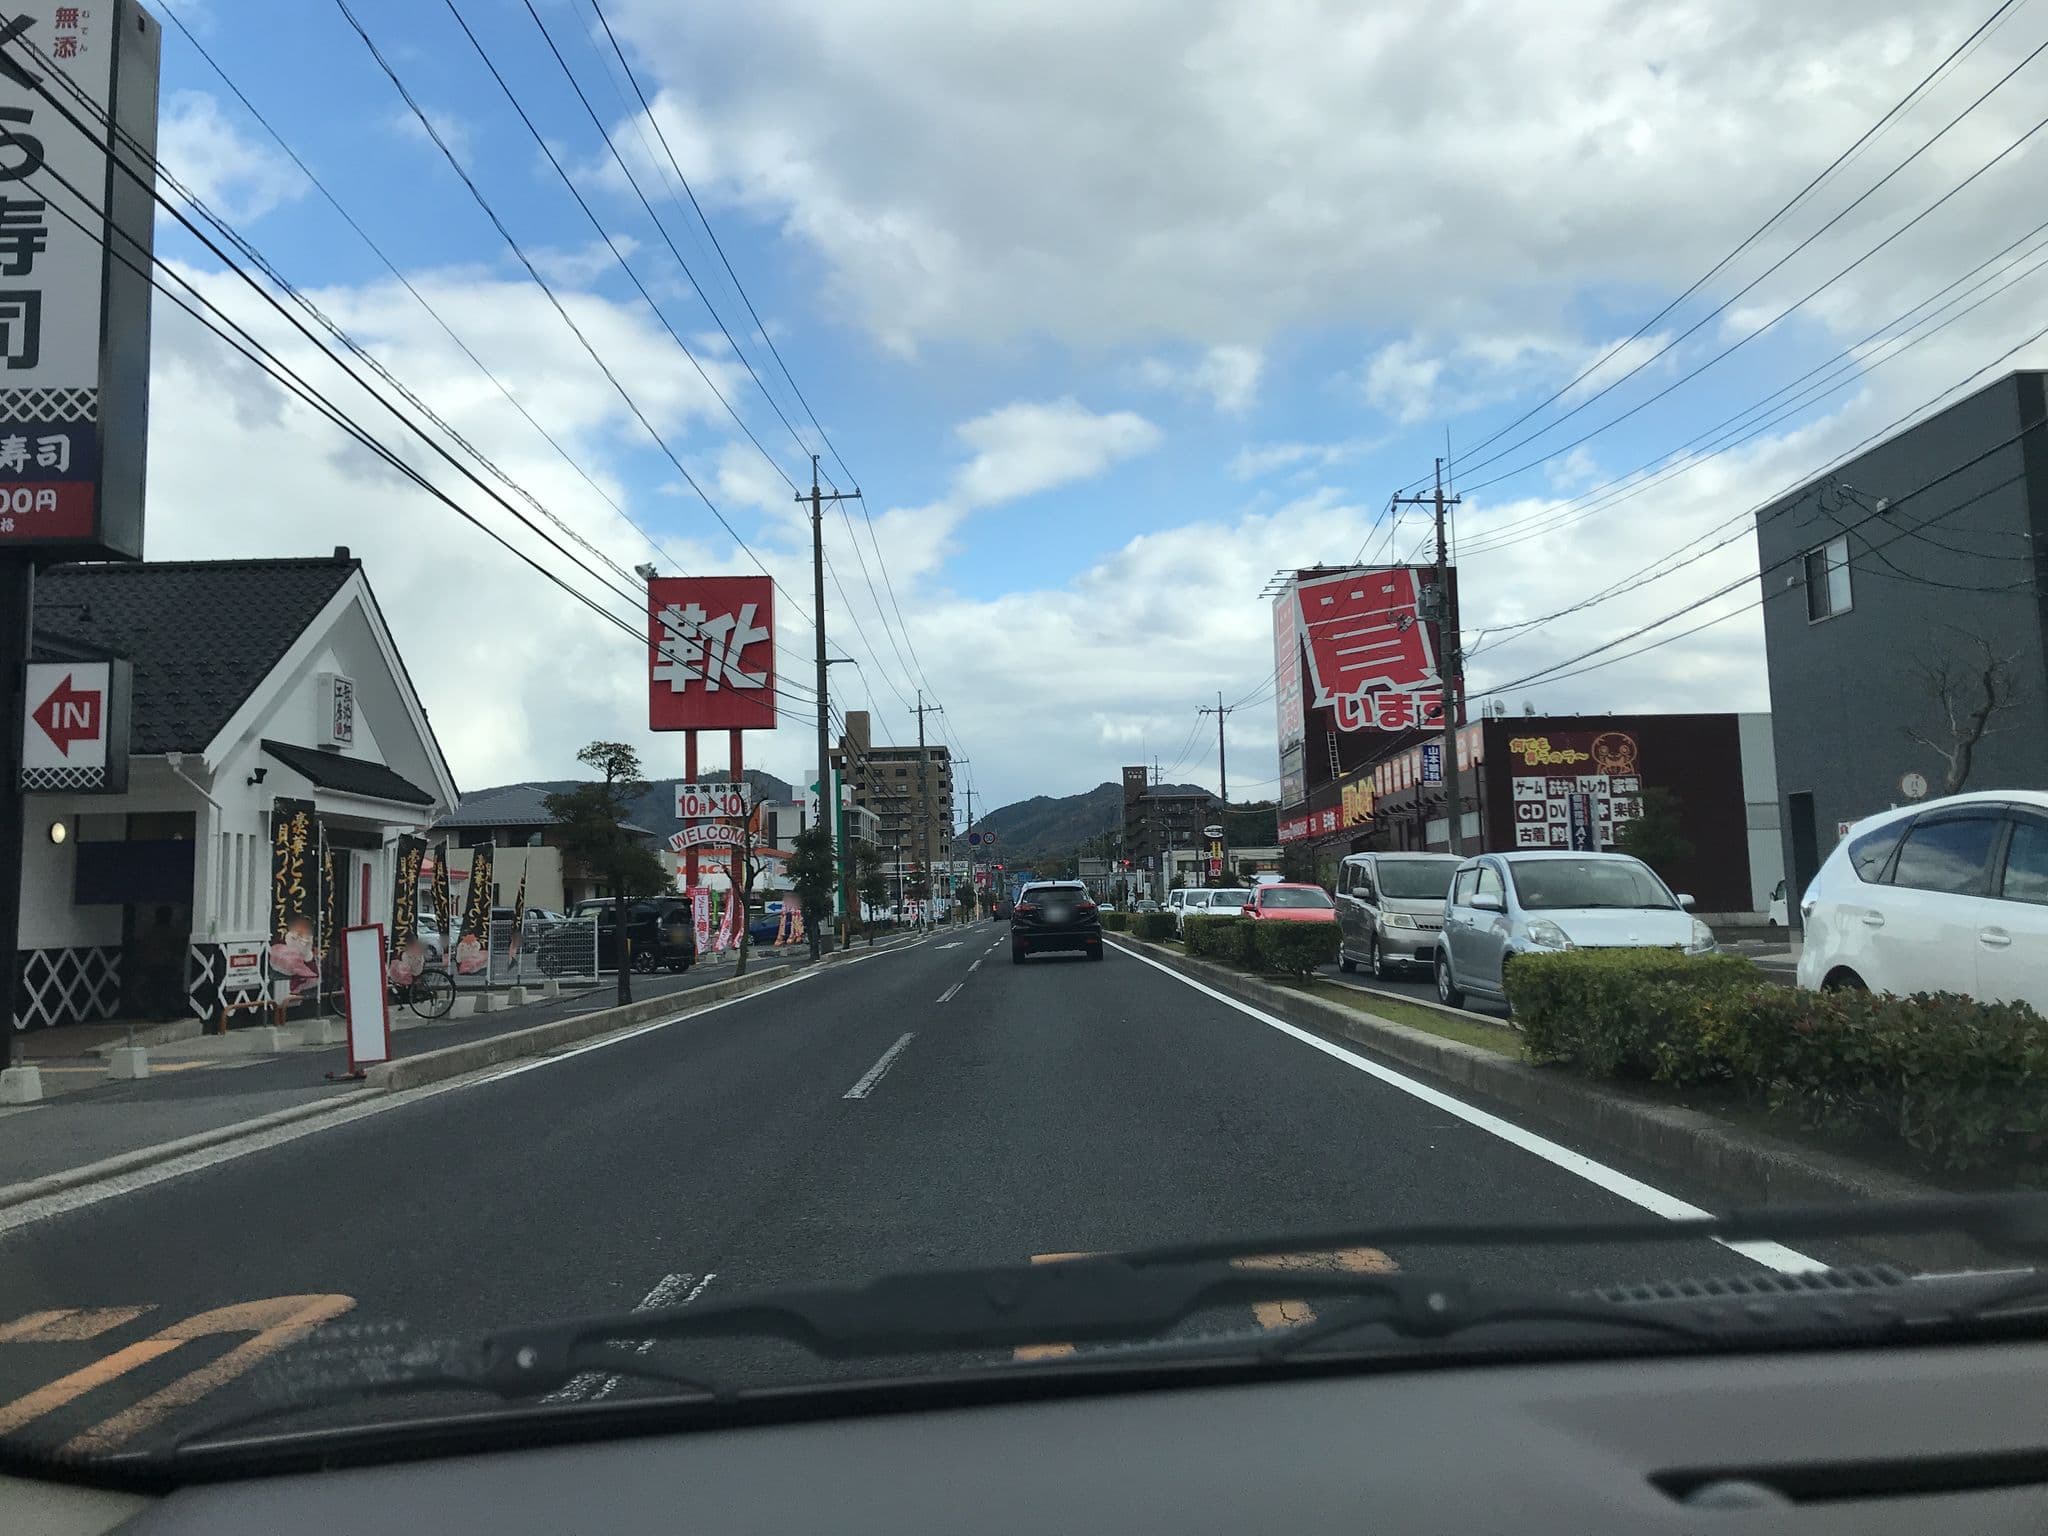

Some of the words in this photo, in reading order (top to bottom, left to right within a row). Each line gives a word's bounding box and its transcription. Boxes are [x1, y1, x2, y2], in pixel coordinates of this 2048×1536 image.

[53, 7, 79, 58] 無添
[653, 603, 770, 692] 靴
[52, 701, 91, 730] IN
[1515, 781, 1543, 794] ゲーム
[1580, 780, 1607, 793] トレカ
[1611, 778, 1639, 794] 家電
[1518, 804, 1544, 819] CD
[1550, 804, 1568, 819] DV
